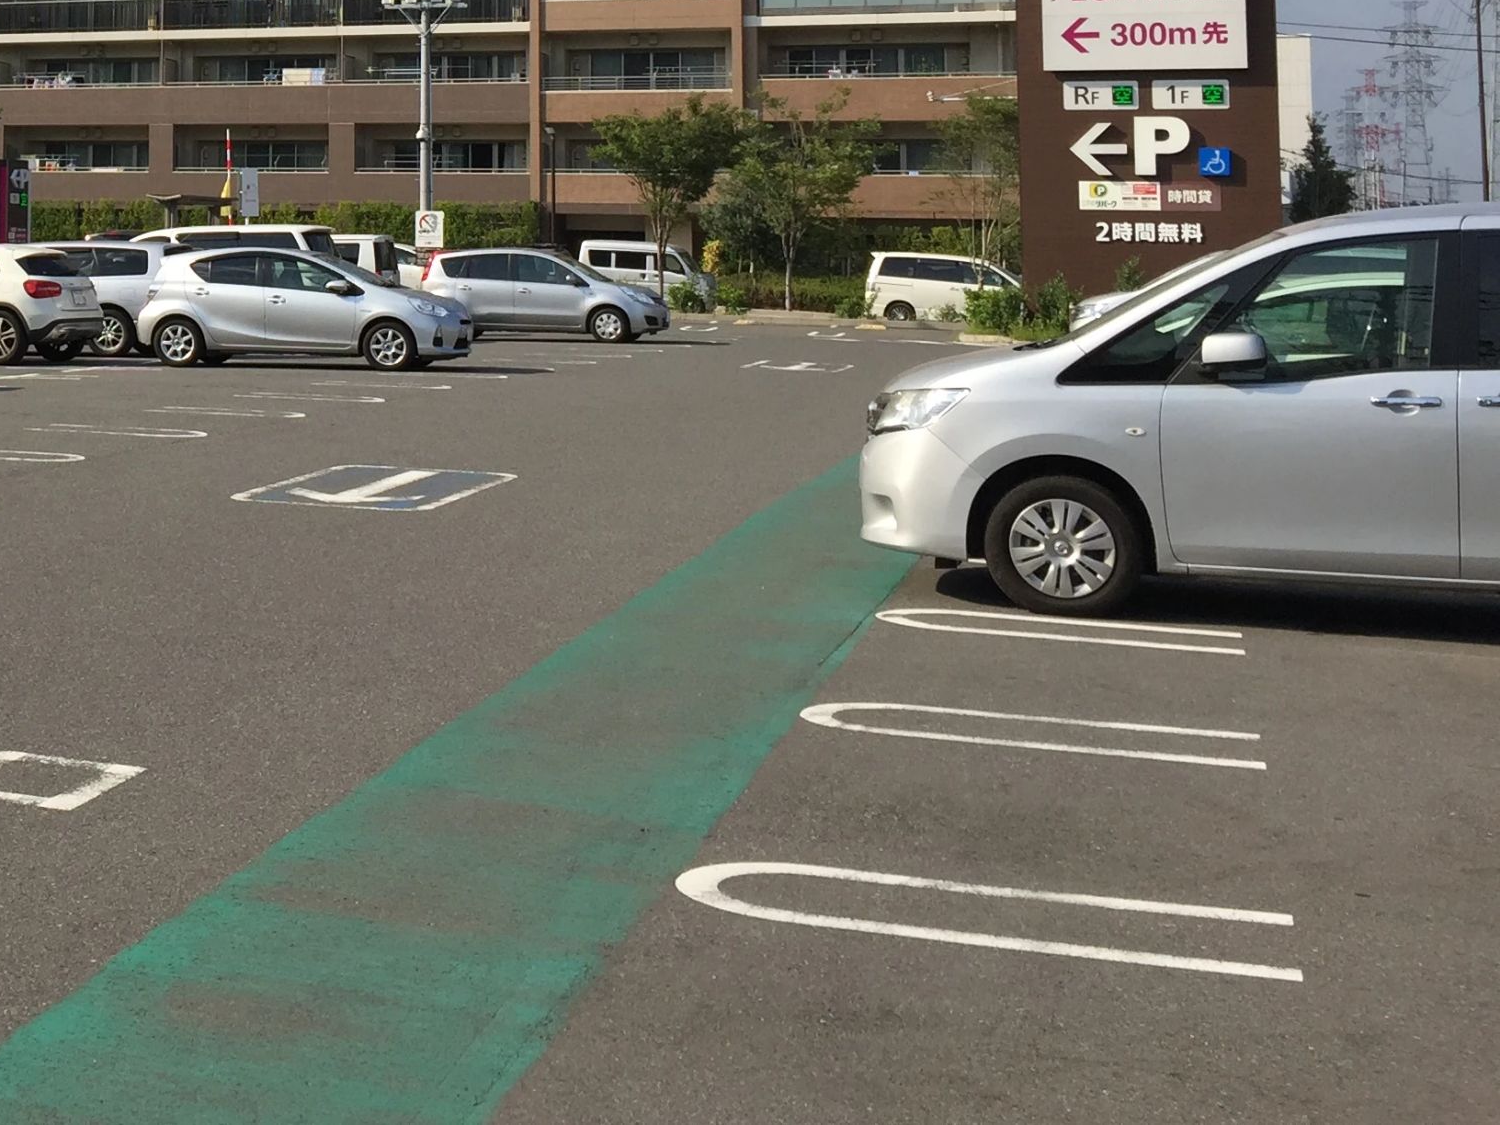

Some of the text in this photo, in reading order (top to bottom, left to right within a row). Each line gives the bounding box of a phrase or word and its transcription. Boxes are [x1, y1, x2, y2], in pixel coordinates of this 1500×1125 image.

[1112, 85, 1133, 105] 空
[1166, 84, 1224, 105] 1F 空
[1133, 116, 1191, 176] P
[1095, 222, 1203, 243] 2時間無料
